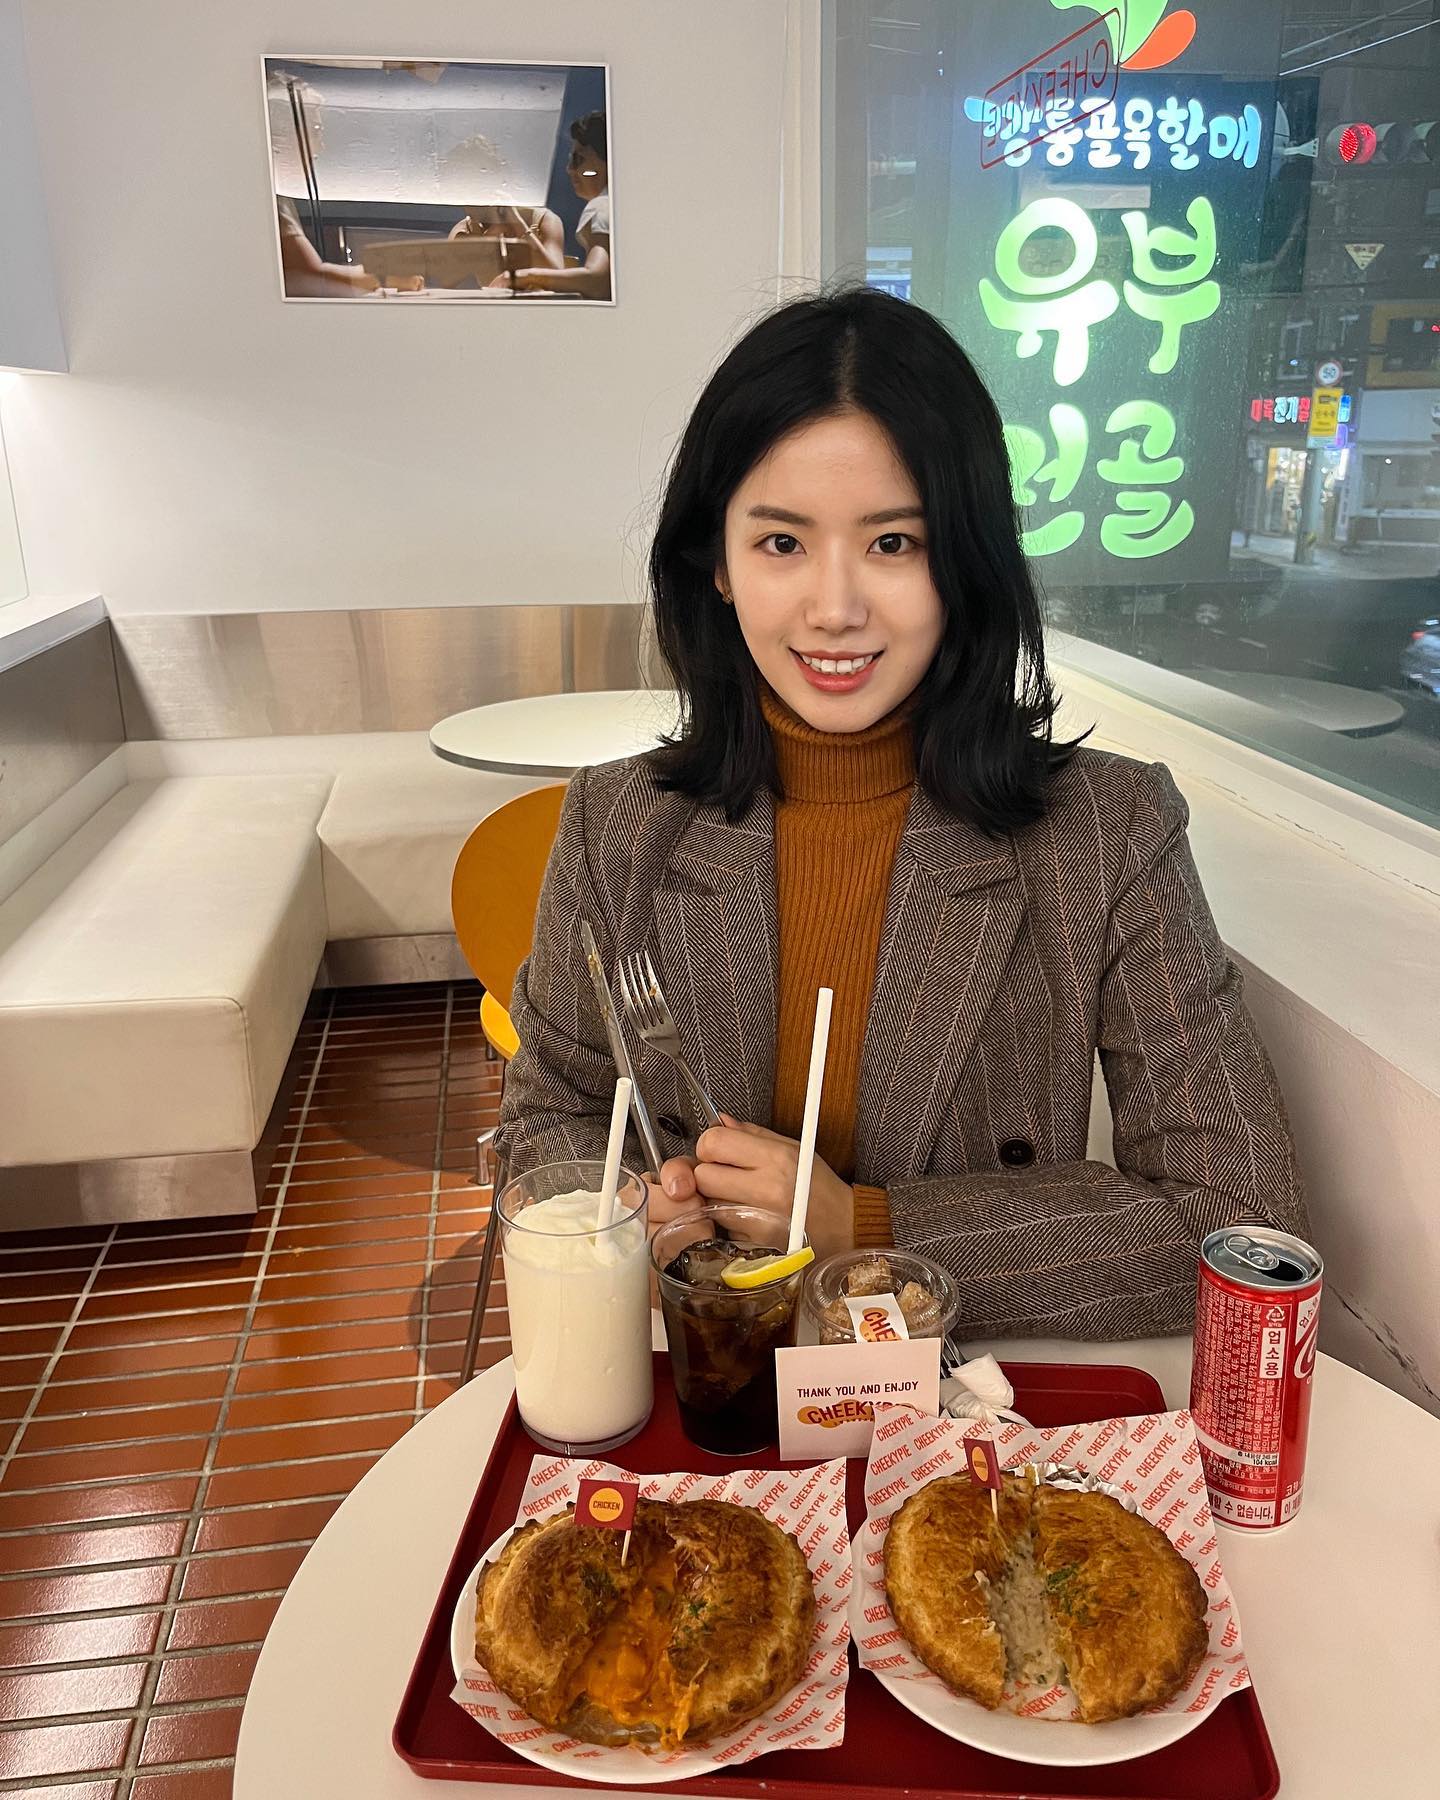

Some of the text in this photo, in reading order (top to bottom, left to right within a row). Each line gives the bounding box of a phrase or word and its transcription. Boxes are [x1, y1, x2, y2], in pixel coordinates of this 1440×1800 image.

[1265, 1330, 1281, 1376] 업소용
[797, 1381, 919, 1398] THANK YOU AND ENJOY
[876, 1414, 914, 1442] CHEEKYPIE
[913, 1420, 954, 1451] CHEEKYPIE
[870, 1444, 912, 1476] CHEEKYPIE
[910, 1449, 954, 1482] CHEEKYPIE
[1136, 1432, 1176, 1478] CHEEKYPIE
[522, 1483, 572, 1517] CHEEKYPIE
[789, 1464, 829, 1510] CHEEKYPIE
[867, 1477, 909, 1506] CHEEKYPIE
[1141, 1467, 1183, 1511] CHEEKYPIE
[592, 1500, 621, 1510] CHICKEN
[1224, 1501, 1233, 1514] 수
[1236, 1504, 1274, 1520] 없습니다.
[767, 1707, 824, 1742] CHEEKYPIE
[712, 1723, 769, 1763] CHEEKYPIE
